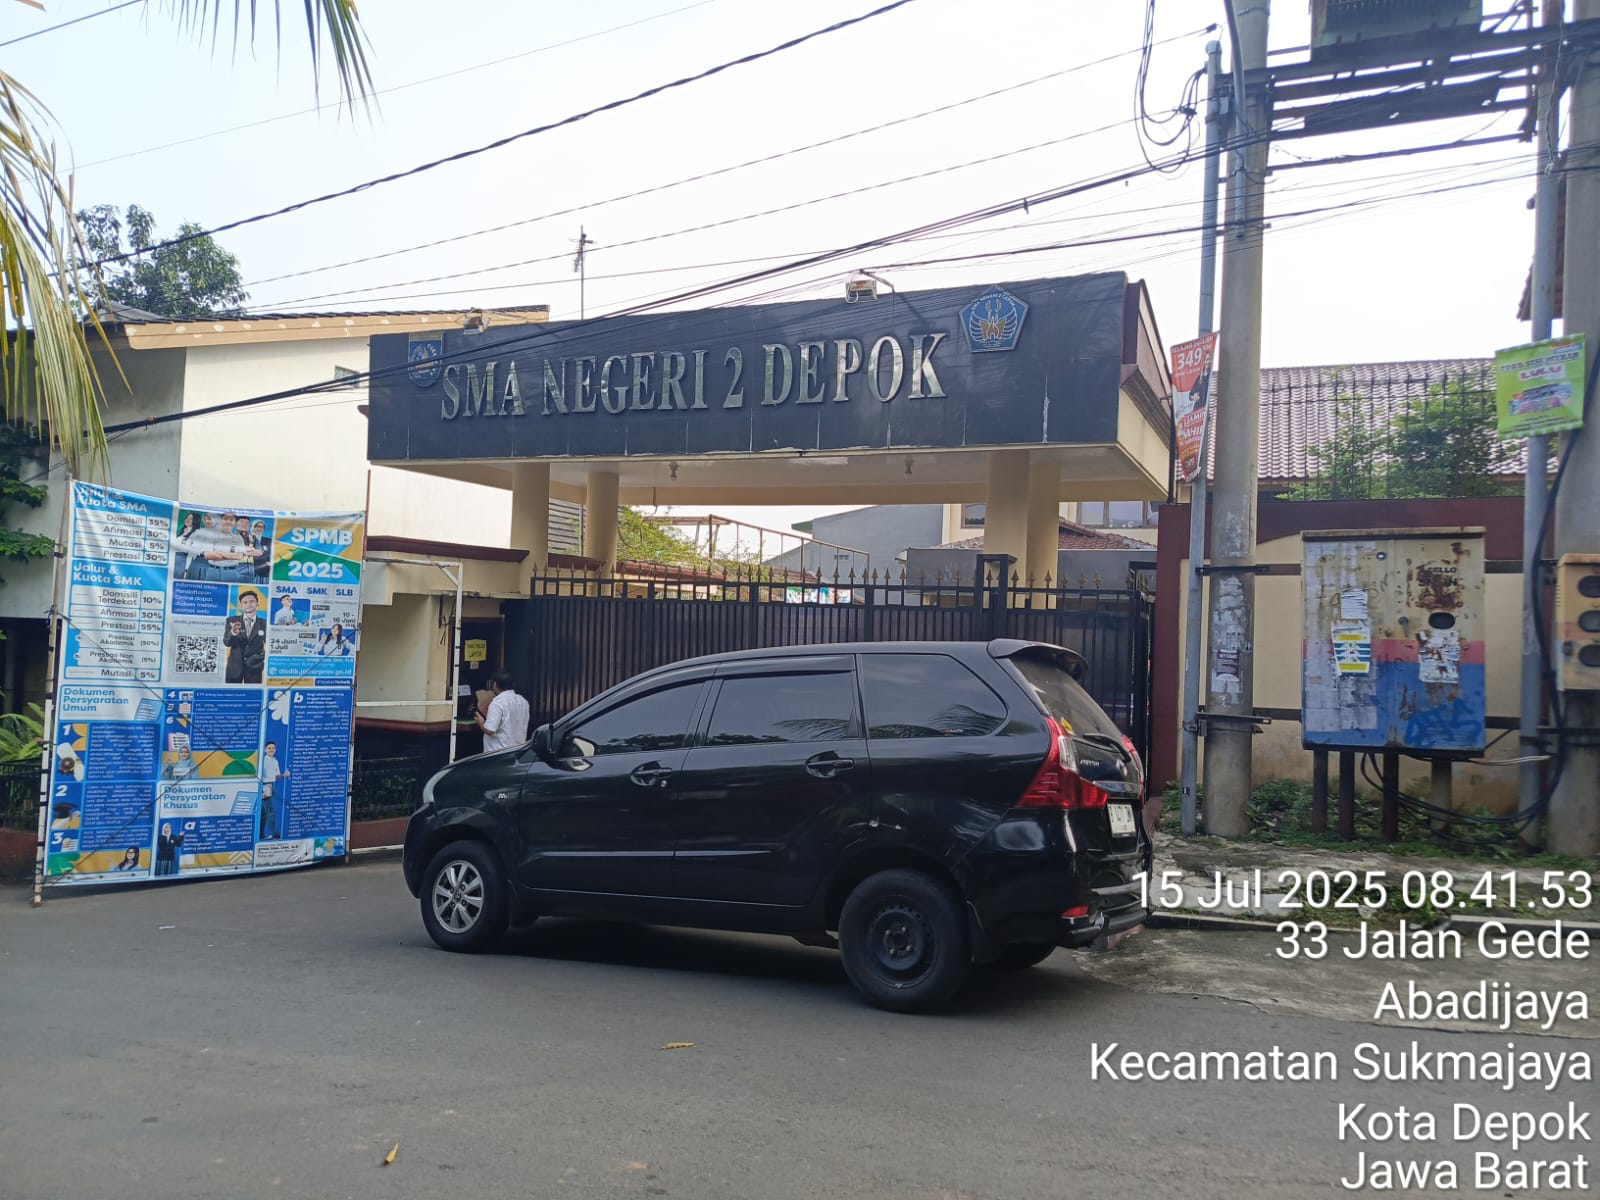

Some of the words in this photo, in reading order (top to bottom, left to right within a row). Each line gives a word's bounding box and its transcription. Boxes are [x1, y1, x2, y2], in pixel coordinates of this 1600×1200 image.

[1177, 348, 1202, 370] 349
[440, 360, 525, 420] SMA
[540, 349, 708, 414] NEGERI
[722, 346, 744, 409] 2
[760, 332, 947, 406] DEPOK
[119, 501, 148, 513] SMA
[106, 514, 143, 525] Domisili
[148, 518, 169, 527] 35%
[103, 526, 142, 536] Afirmasi
[146, 530, 168, 539] 30%
[291, 527, 353, 546] SPMB
[109, 539, 141, 548] Mutasi
[149, 542, 164, 550] 5%
[103, 551, 140, 560] Prestasi
[145, 554, 166, 563] 30%
[73, 562, 106, 573] Jalur
[108, 566, 119, 575] &
[288, 561, 344, 579] 2025
[73, 571, 111, 583] Kuota
[114, 575, 142, 586] SMK
[103, 589, 138, 598] Domisili
[276, 585, 298, 594] SMA
[306, 587, 328, 595] SMK
[98, 596, 138, 606] Terdekat
[142, 597, 162, 605] 10%
[100, 609, 137, 618] Afirmasi
[140, 611, 163, 620] 30%
[101, 621, 136, 630] Prestasi
[140, 623, 161, 632] 55%
[101, 669, 132, 677] Mutasi
[64, 688, 115, 697] Dokumen
[167, 691, 176, 699] 4
[293, 692, 304, 703] b
[64, 696, 130, 707] Persyaratan
[63, 704, 97, 712] Umum
[62, 724, 72, 736] 1
[55, 785, 68, 797] 2
[163, 785, 213, 794] Dokumen
[163, 793, 226, 803] Persyaratan
[163, 801, 199, 810] Khusus
[184, 821, 196, 830] a
[51, 832, 64, 844] 3
